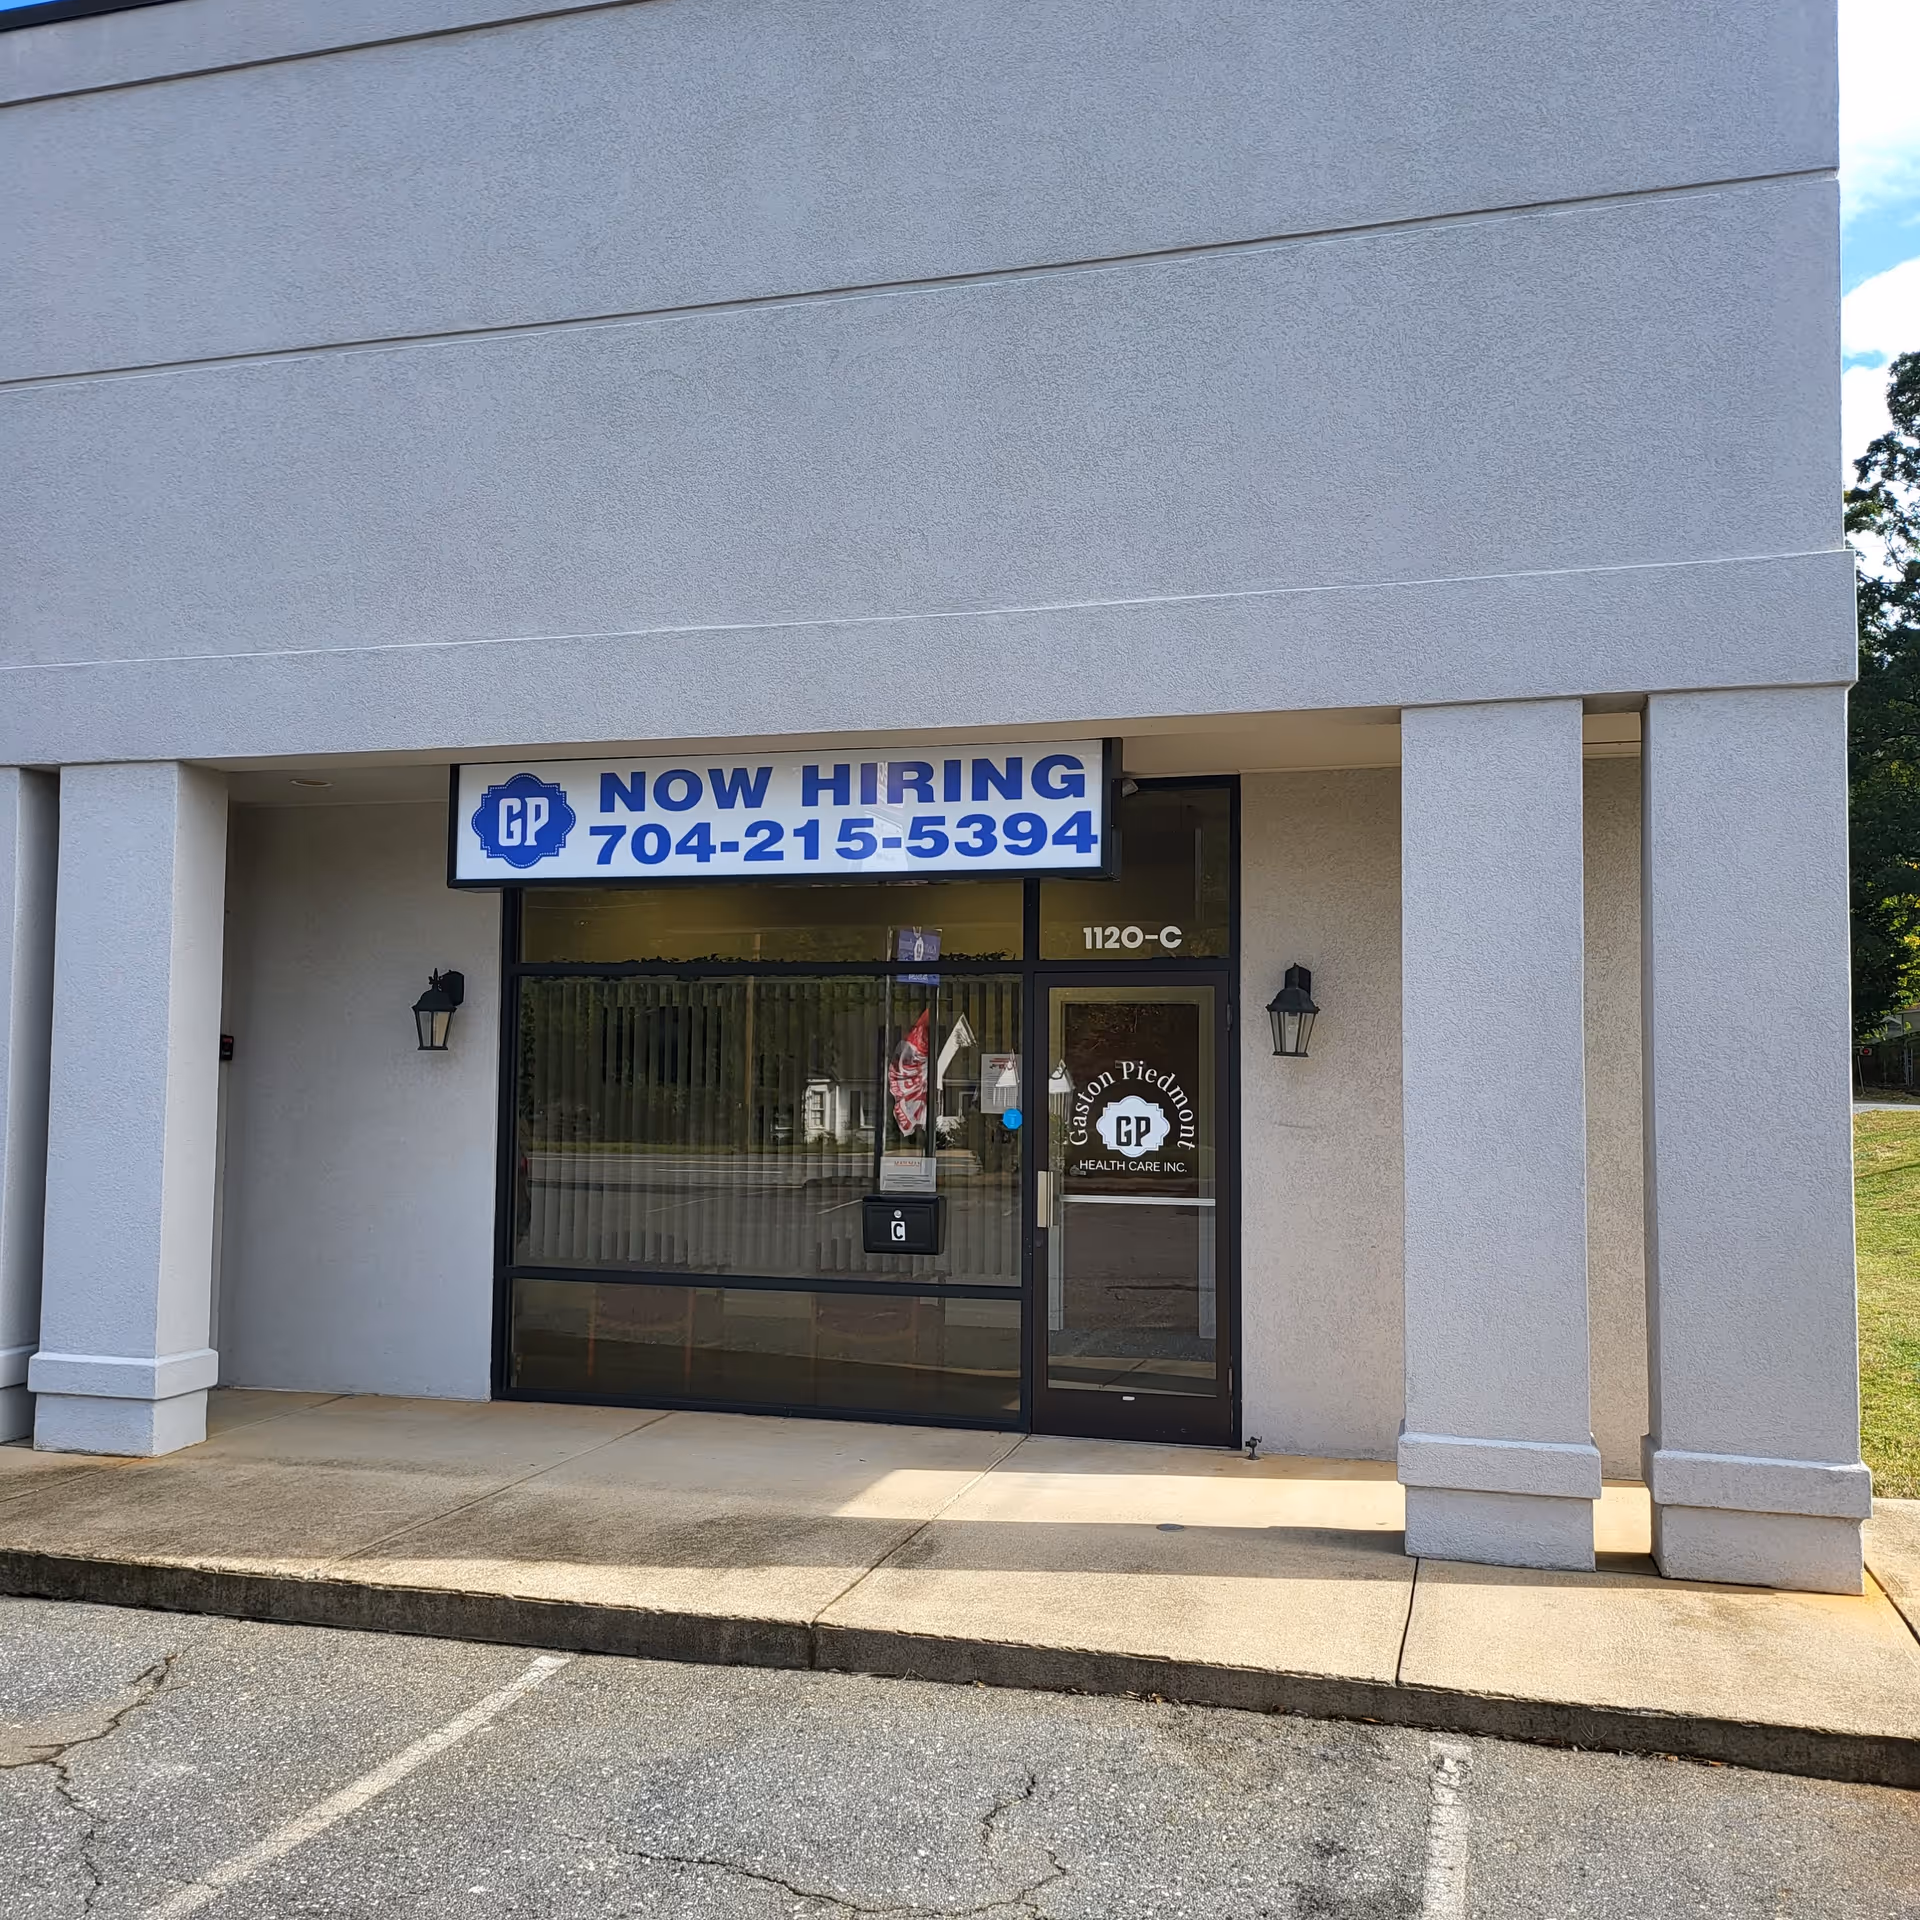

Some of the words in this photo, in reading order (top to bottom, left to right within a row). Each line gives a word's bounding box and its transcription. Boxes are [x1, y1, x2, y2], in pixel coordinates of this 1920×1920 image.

[600, 769, 770, 814] NOW
[802, 756, 1086, 808] HIRING
[498, 797, 550, 847] GP
[588, 810, 1099, 866] 704-215-5394
[1083, 925, 1183, 949] 1120-C
[1069, 1070, 1116, 1147] Gaston
[1121, 1060, 1196, 1151] Piedmont
[1115, 1115, 1151, 1147] GP
[1079, 1159, 1126, 1171] HEALTH
[1128, 1160, 1161, 1172] CARE
[1163, 1162, 1188, 1173] INC.
[893, 1222, 904, 1240] C
